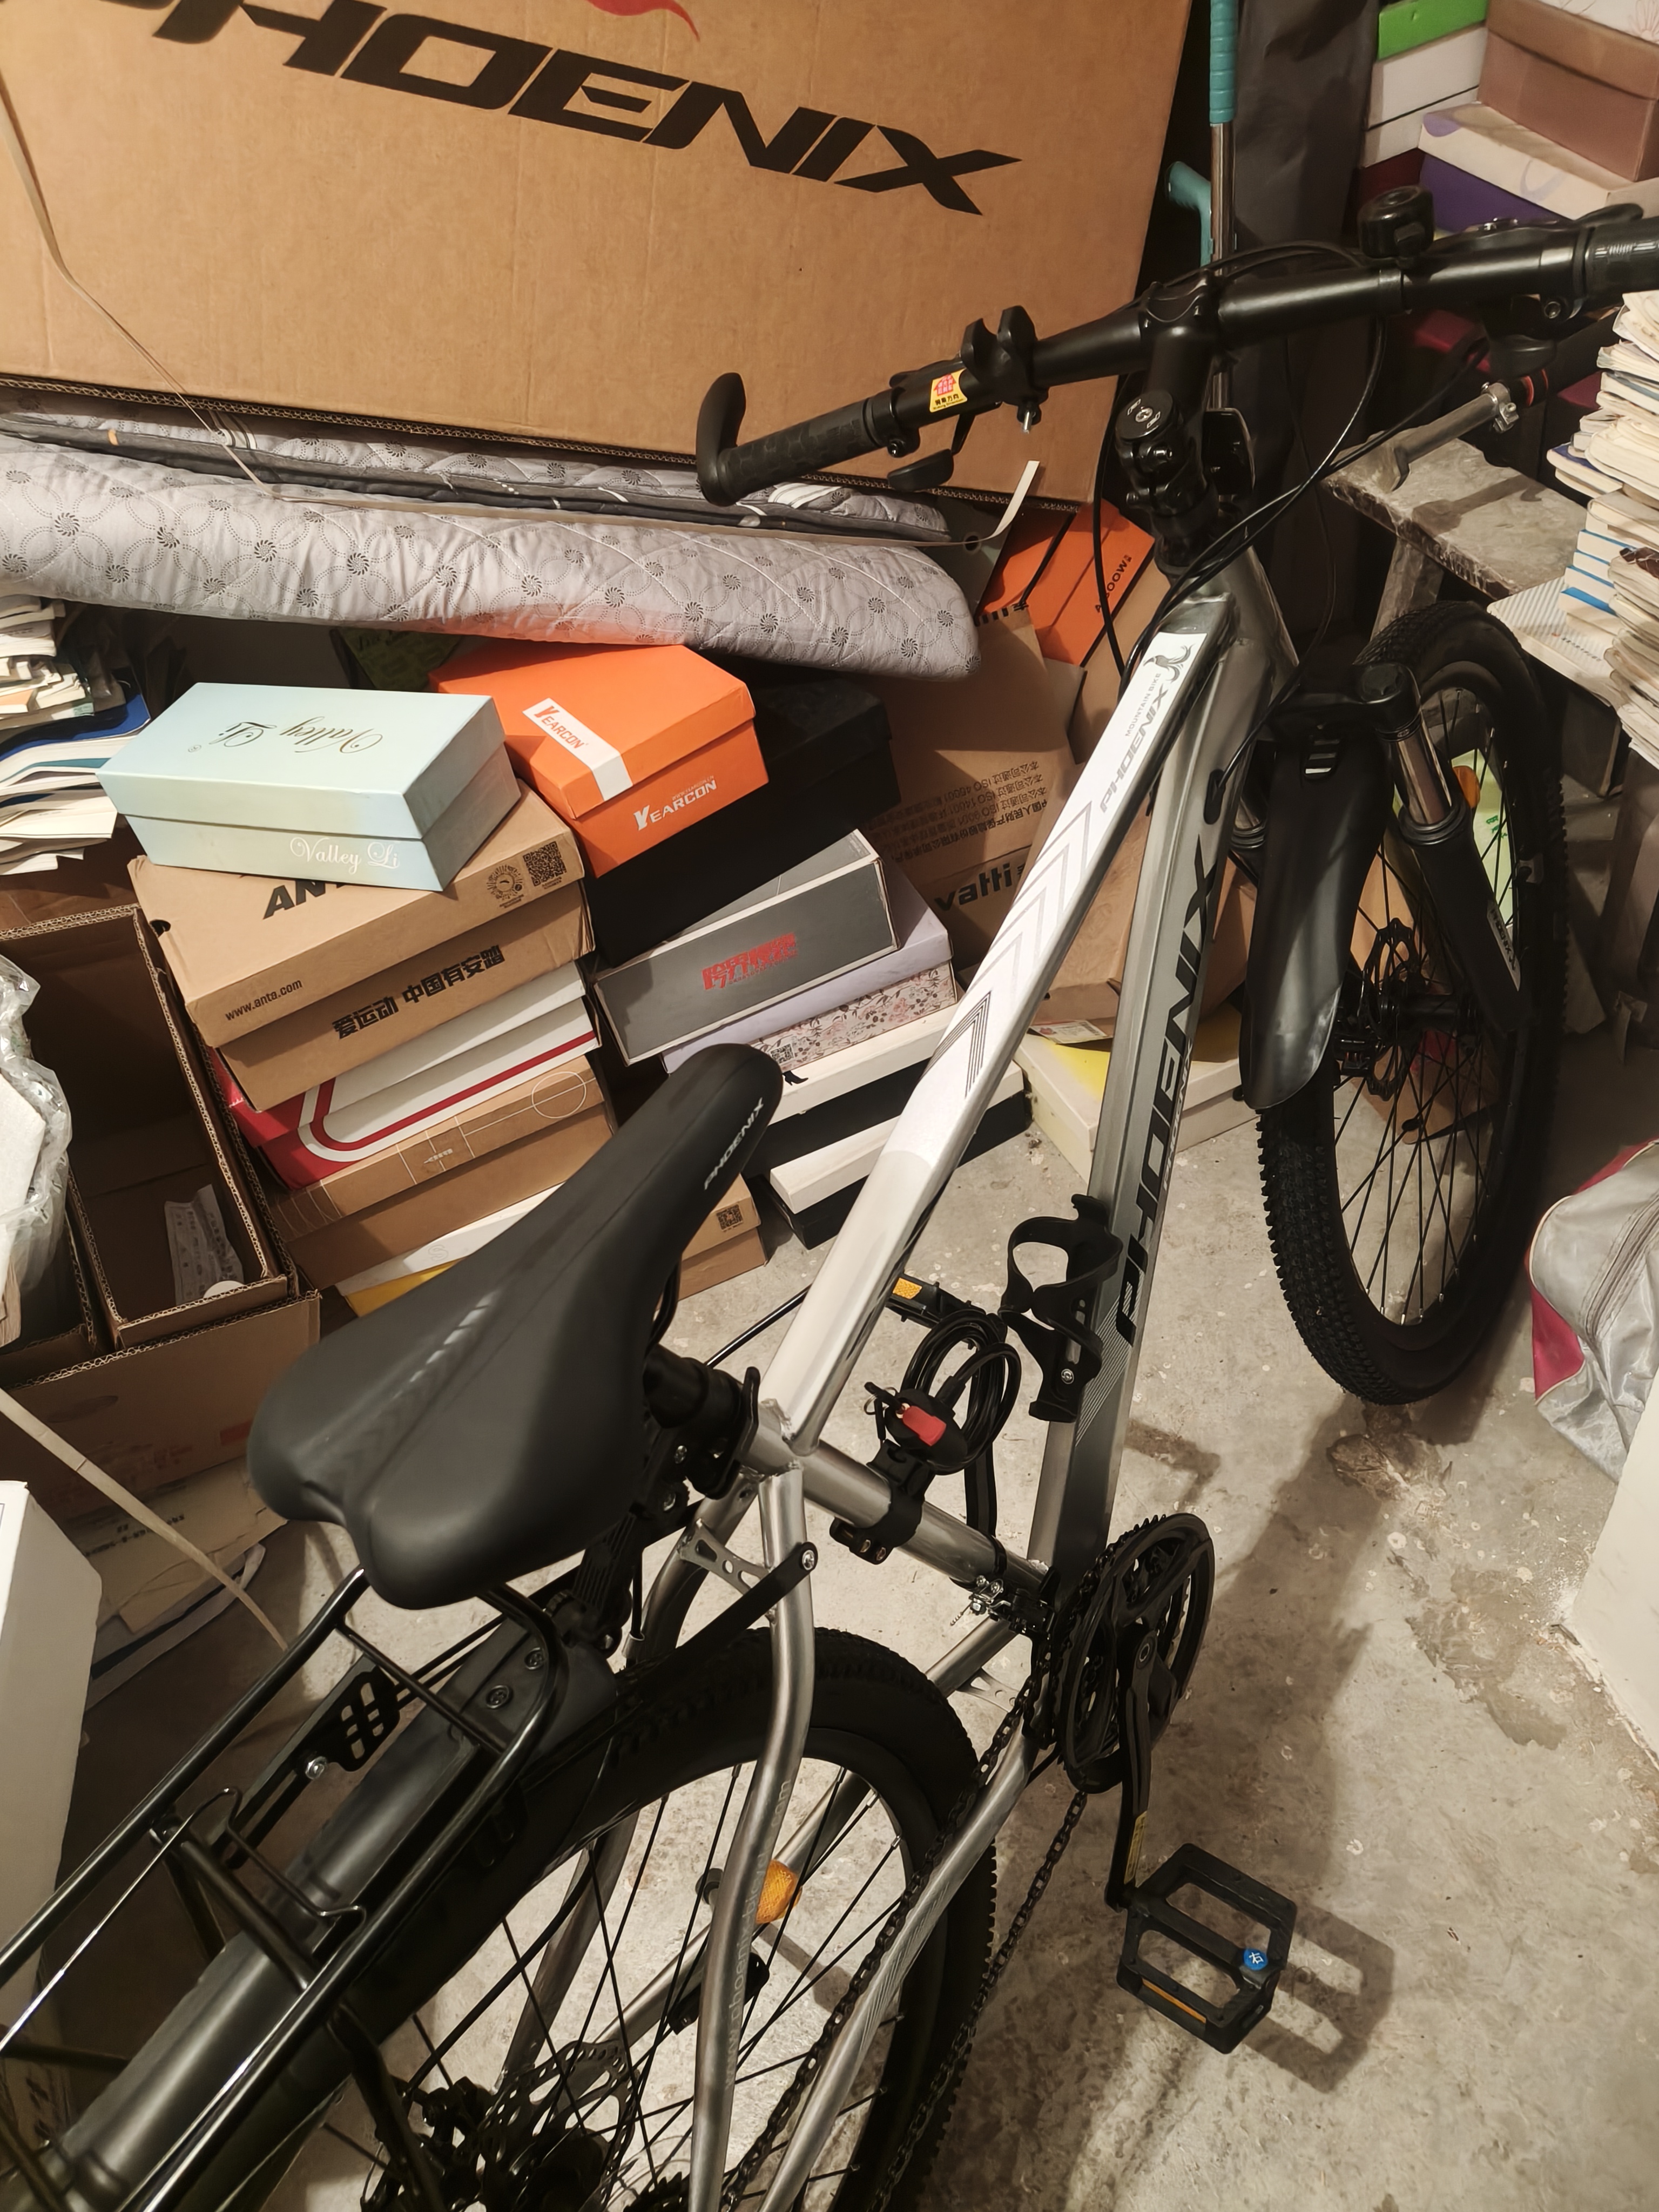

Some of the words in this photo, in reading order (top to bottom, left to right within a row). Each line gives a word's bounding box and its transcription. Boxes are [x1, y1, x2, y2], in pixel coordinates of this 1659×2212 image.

[102, 0, 1022, 215] HOENIX
[534, 705, 584, 749] YEARCON
[1125, 693, 1150, 737] MOUNTAIN
[1148, 673, 1161, 693] BIKE
[279, 716, 383, 753] Valley
[1100, 683, 1169, 813] PHOENIX
[633, 779, 717, 831] YEARCON
[290, 837, 362, 875] Valley
[367, 841, 401, 869] Li
[934, 863, 1013, 912] vatti
[225, 979, 303, 1021] www.anta.com
[332, 996, 400, 1040] 爱运动
[402, 945, 505, 1003] 中国有安踏
[1116, 833, 1217, 1347] PHOENIX
[704, 1097, 764, 1191] PHOENIX
[1248, 1952, 1264, 1964] 右
